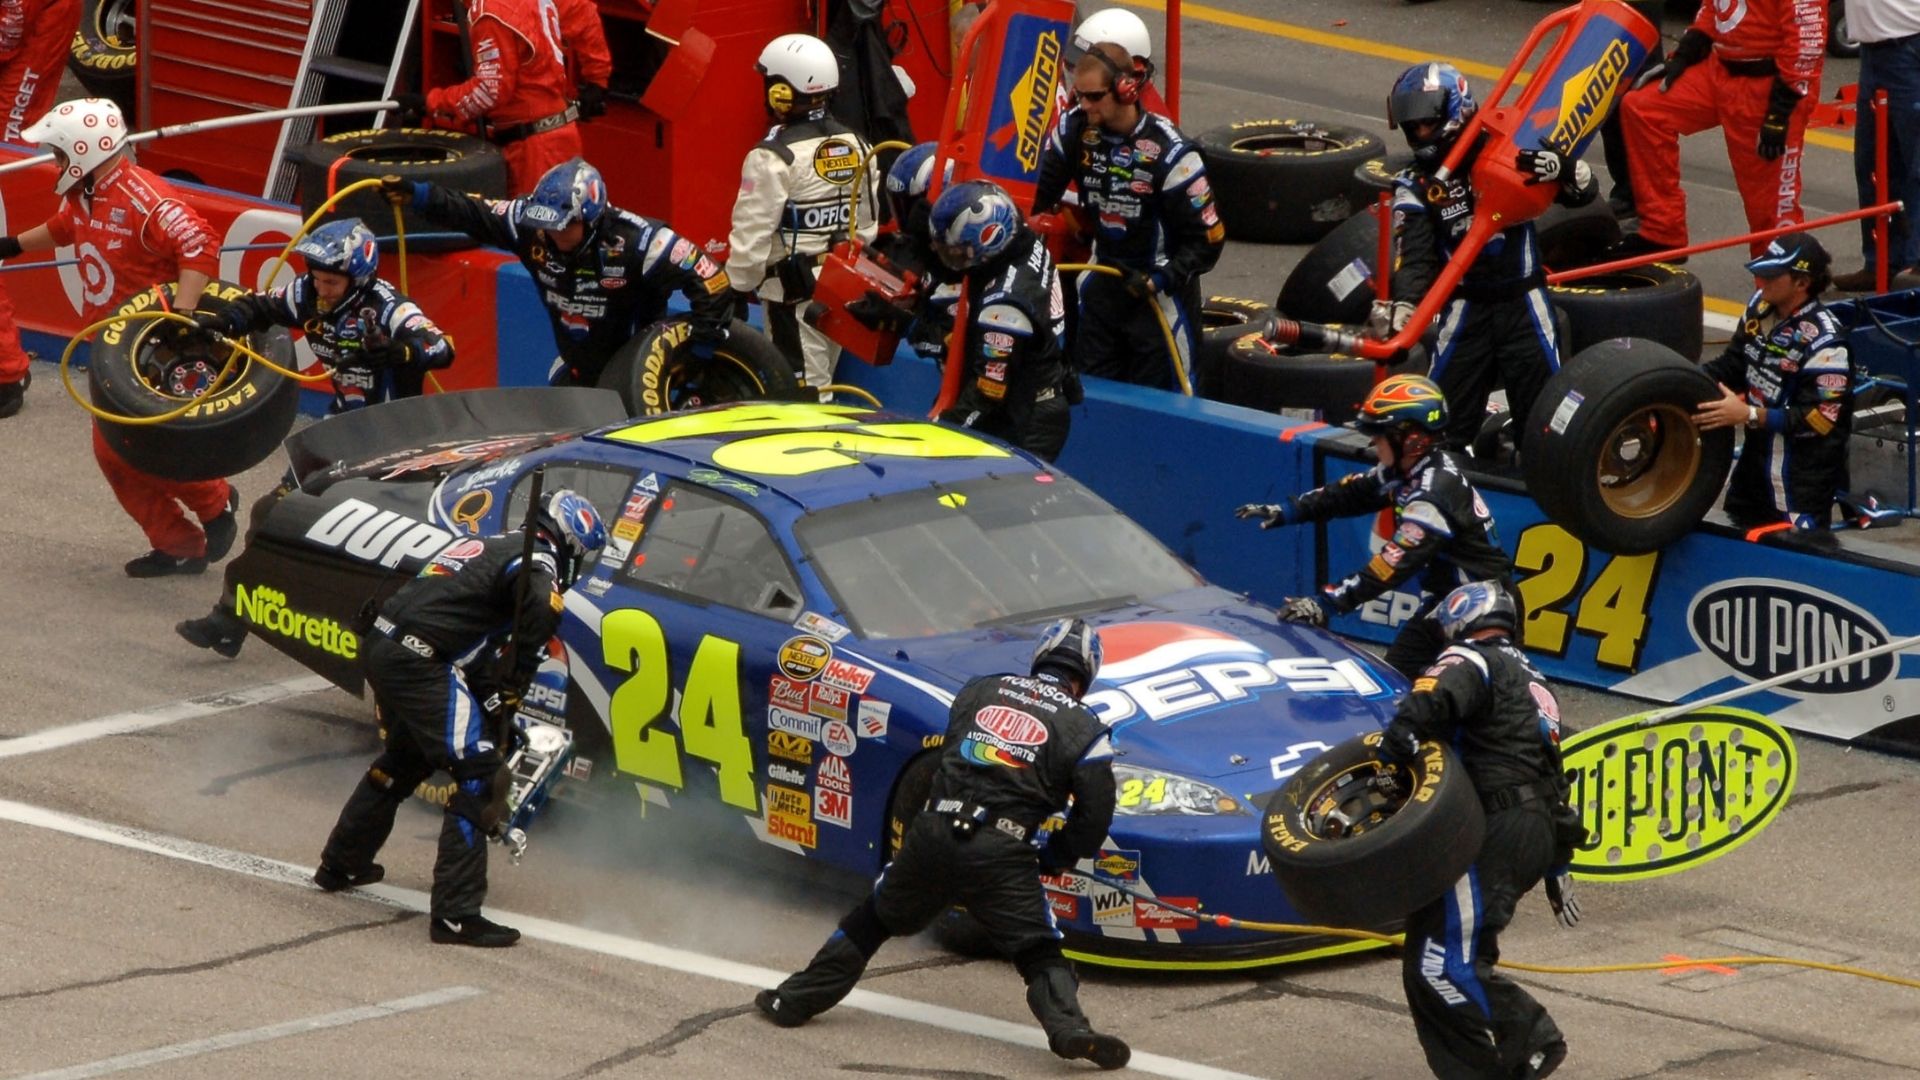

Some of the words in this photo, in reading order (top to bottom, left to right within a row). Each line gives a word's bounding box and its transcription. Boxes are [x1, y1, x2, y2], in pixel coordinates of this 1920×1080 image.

[4, 67, 40, 142] TARGET
[1023, 37, 1060, 165] SUNOCO
[1554, 45, 1628, 150] SUNOCO
[822, 158, 852, 169] NEXTEL
[1778, 146, 1799, 214] TARGET
[526, 205, 559, 222] DUPONT
[804, 203, 851, 228] OFFIC
[546, 290, 605, 318] PEPSI
[184, 383, 257, 418] EAGLE
[1427, 409, 1440, 422] 24
[642, 478, 656, 487] GP
[305, 498, 453, 569] DUP
[1513, 523, 1659, 669] 24
[236, 583, 358, 660] Nicorette
[788, 649, 817, 666] NEXTEL
[826, 660, 872, 688] Holley
[524, 684, 567, 711] EPSI
[770, 677, 809, 700] Bud
[1001, 674, 1079, 709] ROBINSON
[602, 608, 758, 812] 24
[769, 707, 819, 735] Commit
[828, 721, 850, 744] EA
[980, 707, 1044, 744] DUPONT
[966, 730, 1037, 763] MOTORSPORTS
[768, 763, 806, 786] Gillette
[818, 755, 851, 783] MAC
[780, 791, 803, 805] Auto
[818, 776, 851, 793] TOOLS
[1118, 777, 1167, 808] 24
[1576, 738, 1762, 852] UPONT
[779, 801, 807, 816] Meter
[818, 790, 849, 821] 3M
[768, 813, 815, 846] Stant
[1268, 813, 1309, 853] EAGLE
[1095, 859, 1137, 871] SUNOCO
[1094, 890, 1131, 912] WIX
[1421, 937, 1469, 1006] DUPONT
